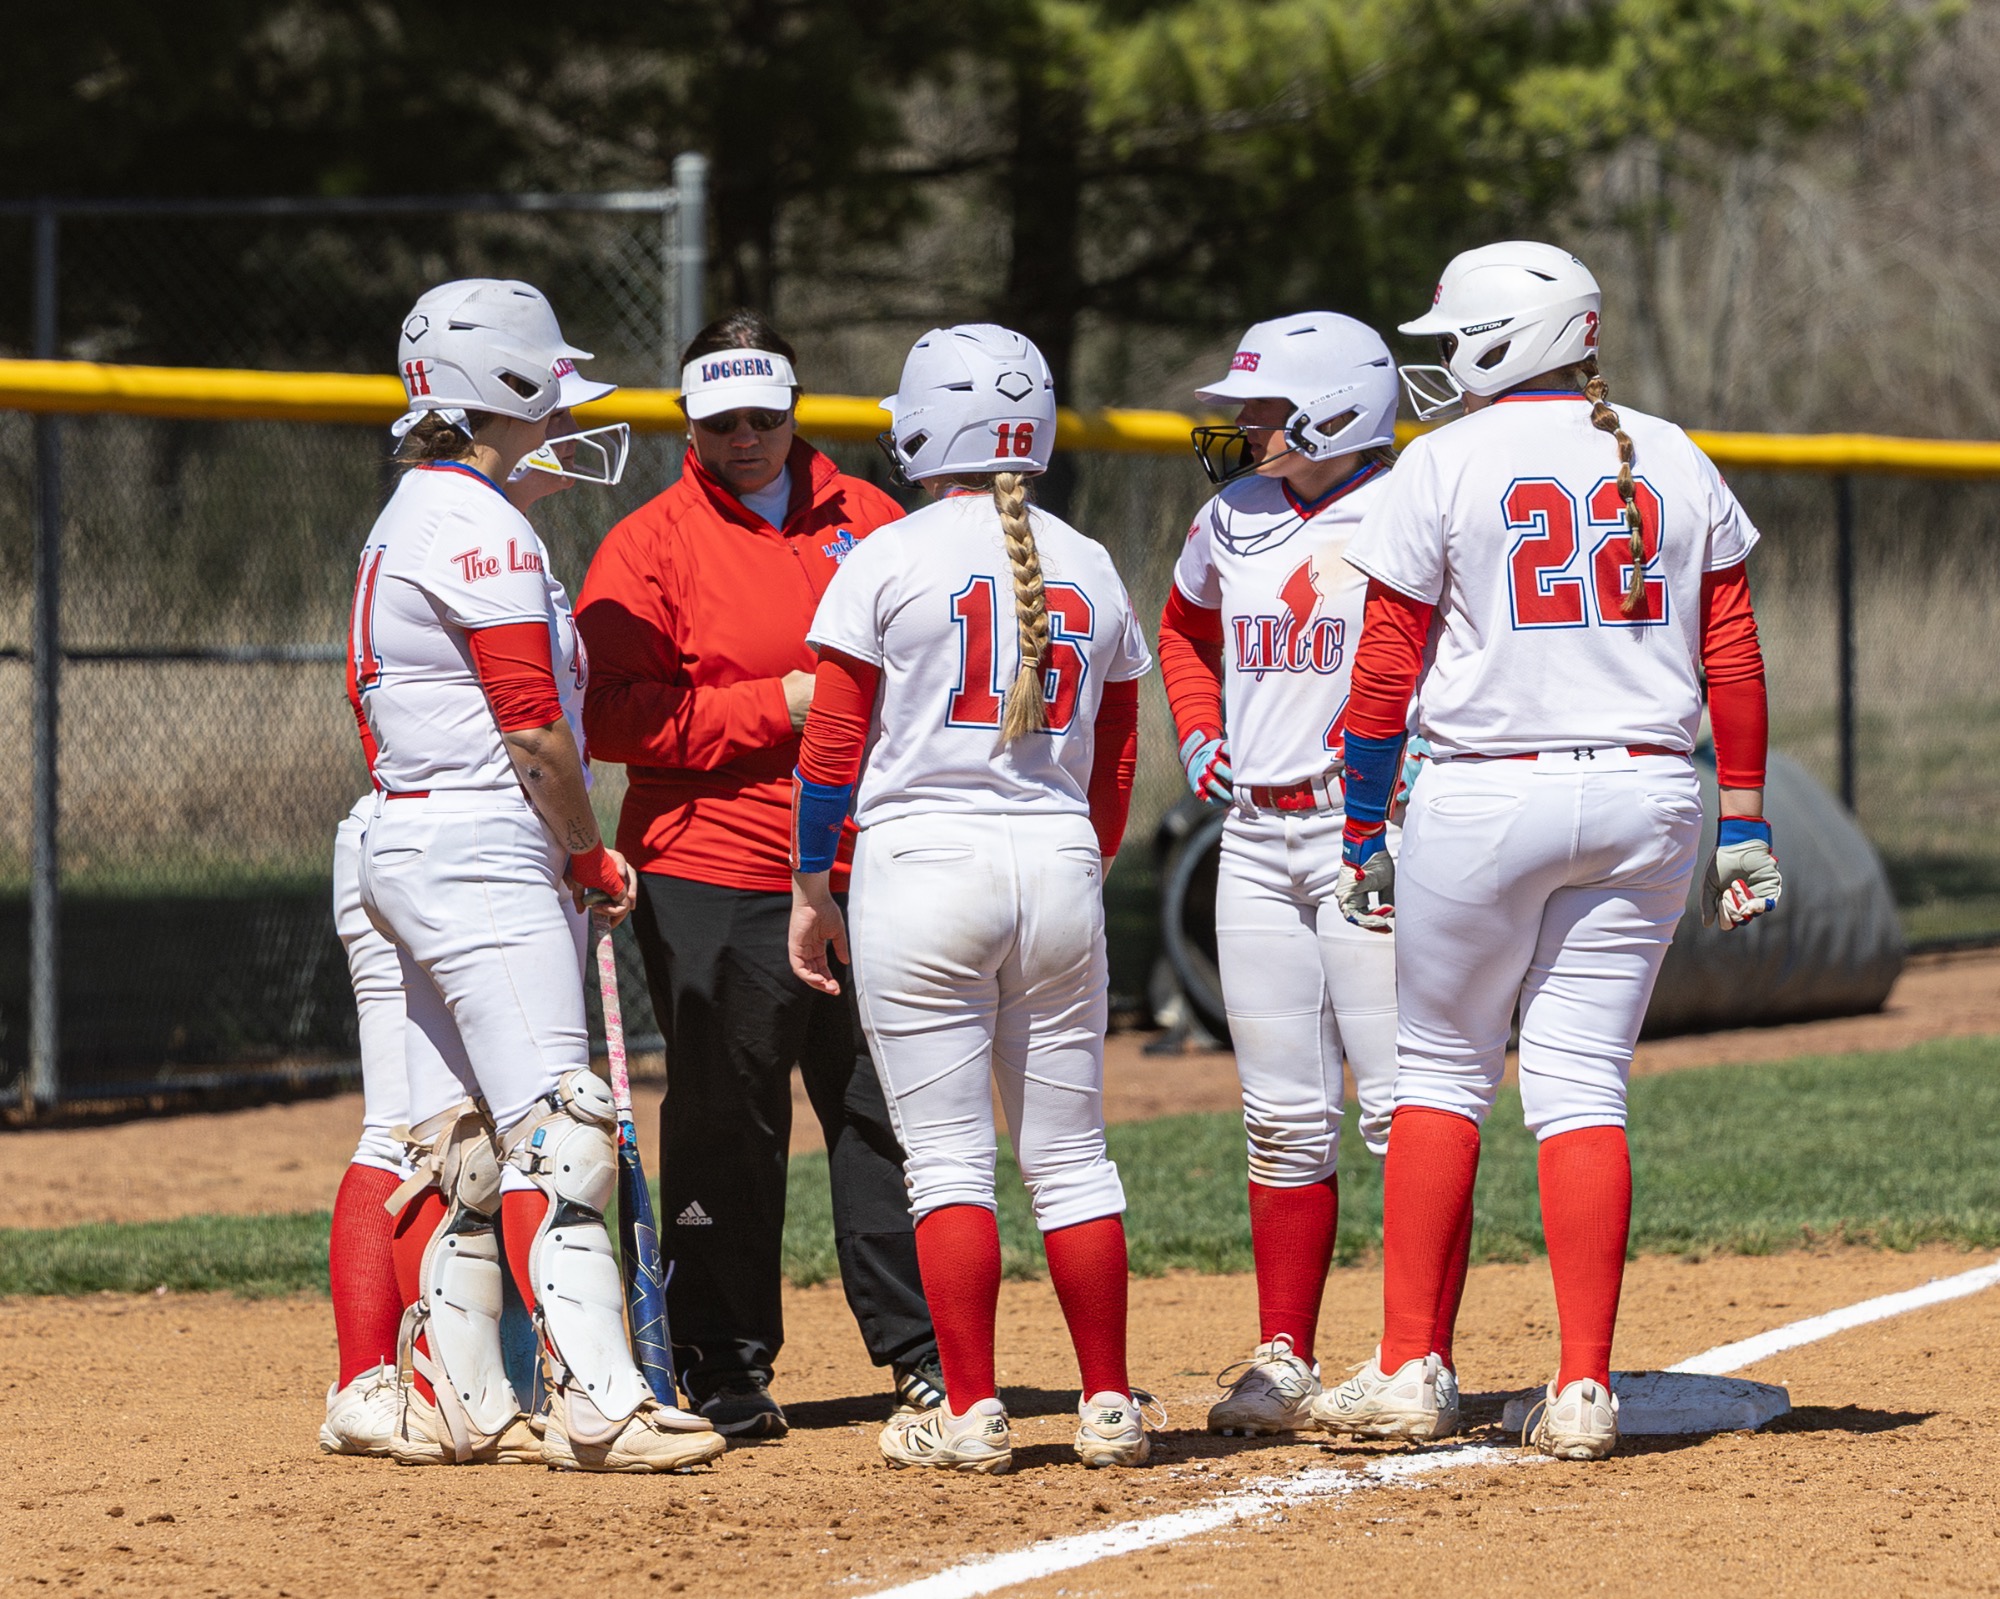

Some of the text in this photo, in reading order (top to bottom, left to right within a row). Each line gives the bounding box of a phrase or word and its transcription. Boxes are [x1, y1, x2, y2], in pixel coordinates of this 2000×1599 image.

[1465, 321, 1502, 334] EASTON
[1584, 311, 1599, 347] 2
[405, 359, 431, 397] 11
[701, 358, 774, 383] LOGGERS
[1309, 385, 1354, 406] EVOSHIELD
[994, 422, 1034, 459] 16
[450, 546, 501, 584] The
[1500, 475, 1669, 631] 22
[944, 575, 1095, 736] 16
[1232, 616, 1346, 675] LLCC
[676, 1216, 713, 1226] adidas
